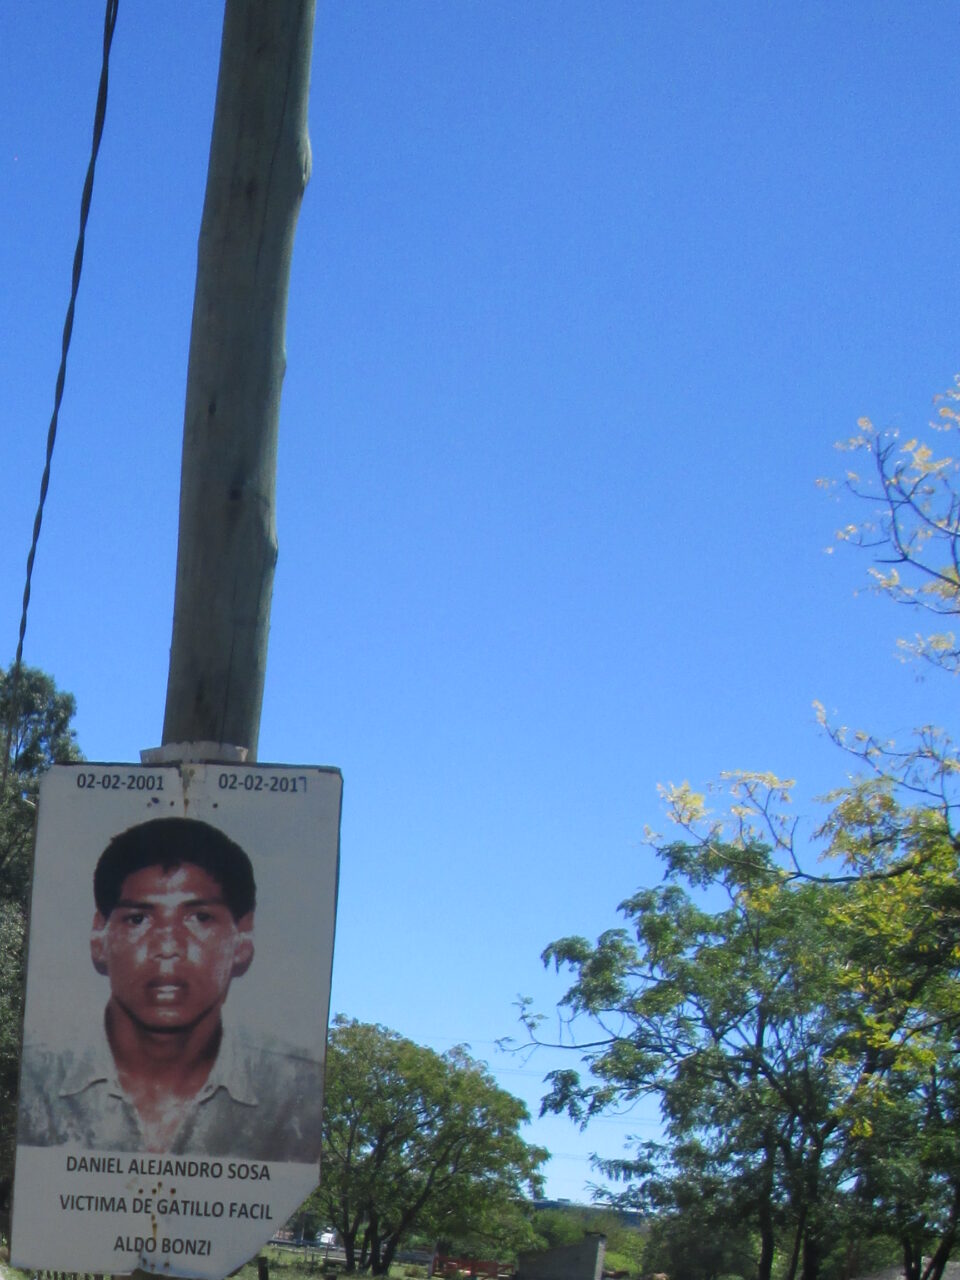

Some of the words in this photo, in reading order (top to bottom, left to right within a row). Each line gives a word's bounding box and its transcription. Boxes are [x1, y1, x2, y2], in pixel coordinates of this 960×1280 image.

[77, 773, 165, 792] 02-02-2001
[66, 1156, 124, 1174] DANIEL
[128, 1159, 223, 1179] ALEJANDRO
[227, 1163, 271, 1181] SOSA
[60, 1194, 128, 1213] VICTIMA
[132, 1199, 153, 1214] DE
[156, 1199, 224, 1217] GATILLO
[229, 1202, 273, 1220] FACIL
[114, 1236, 157, 1253] ALDO
[161, 1239, 212, 1256] BONZI
